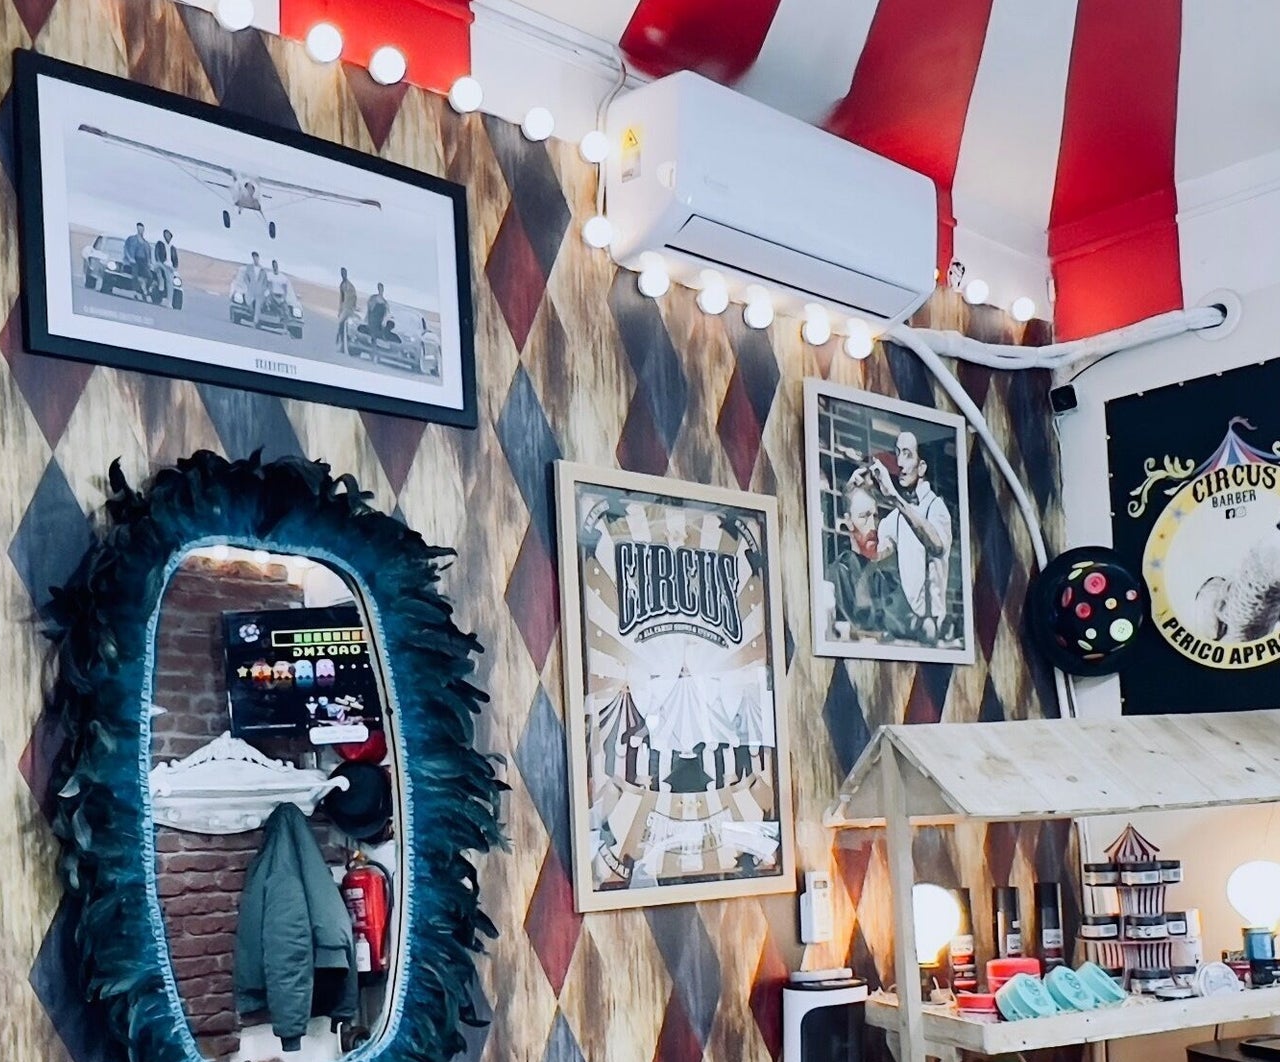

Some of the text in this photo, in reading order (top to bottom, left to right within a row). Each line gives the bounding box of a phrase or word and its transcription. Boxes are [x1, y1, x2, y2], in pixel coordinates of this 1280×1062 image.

[1192, 464, 1277, 504] CIRCUS
[1211, 489, 1257, 508] BARBER
[615, 542, 743, 644] CIRCUS
[1162, 616, 1225, 664] PERICO
